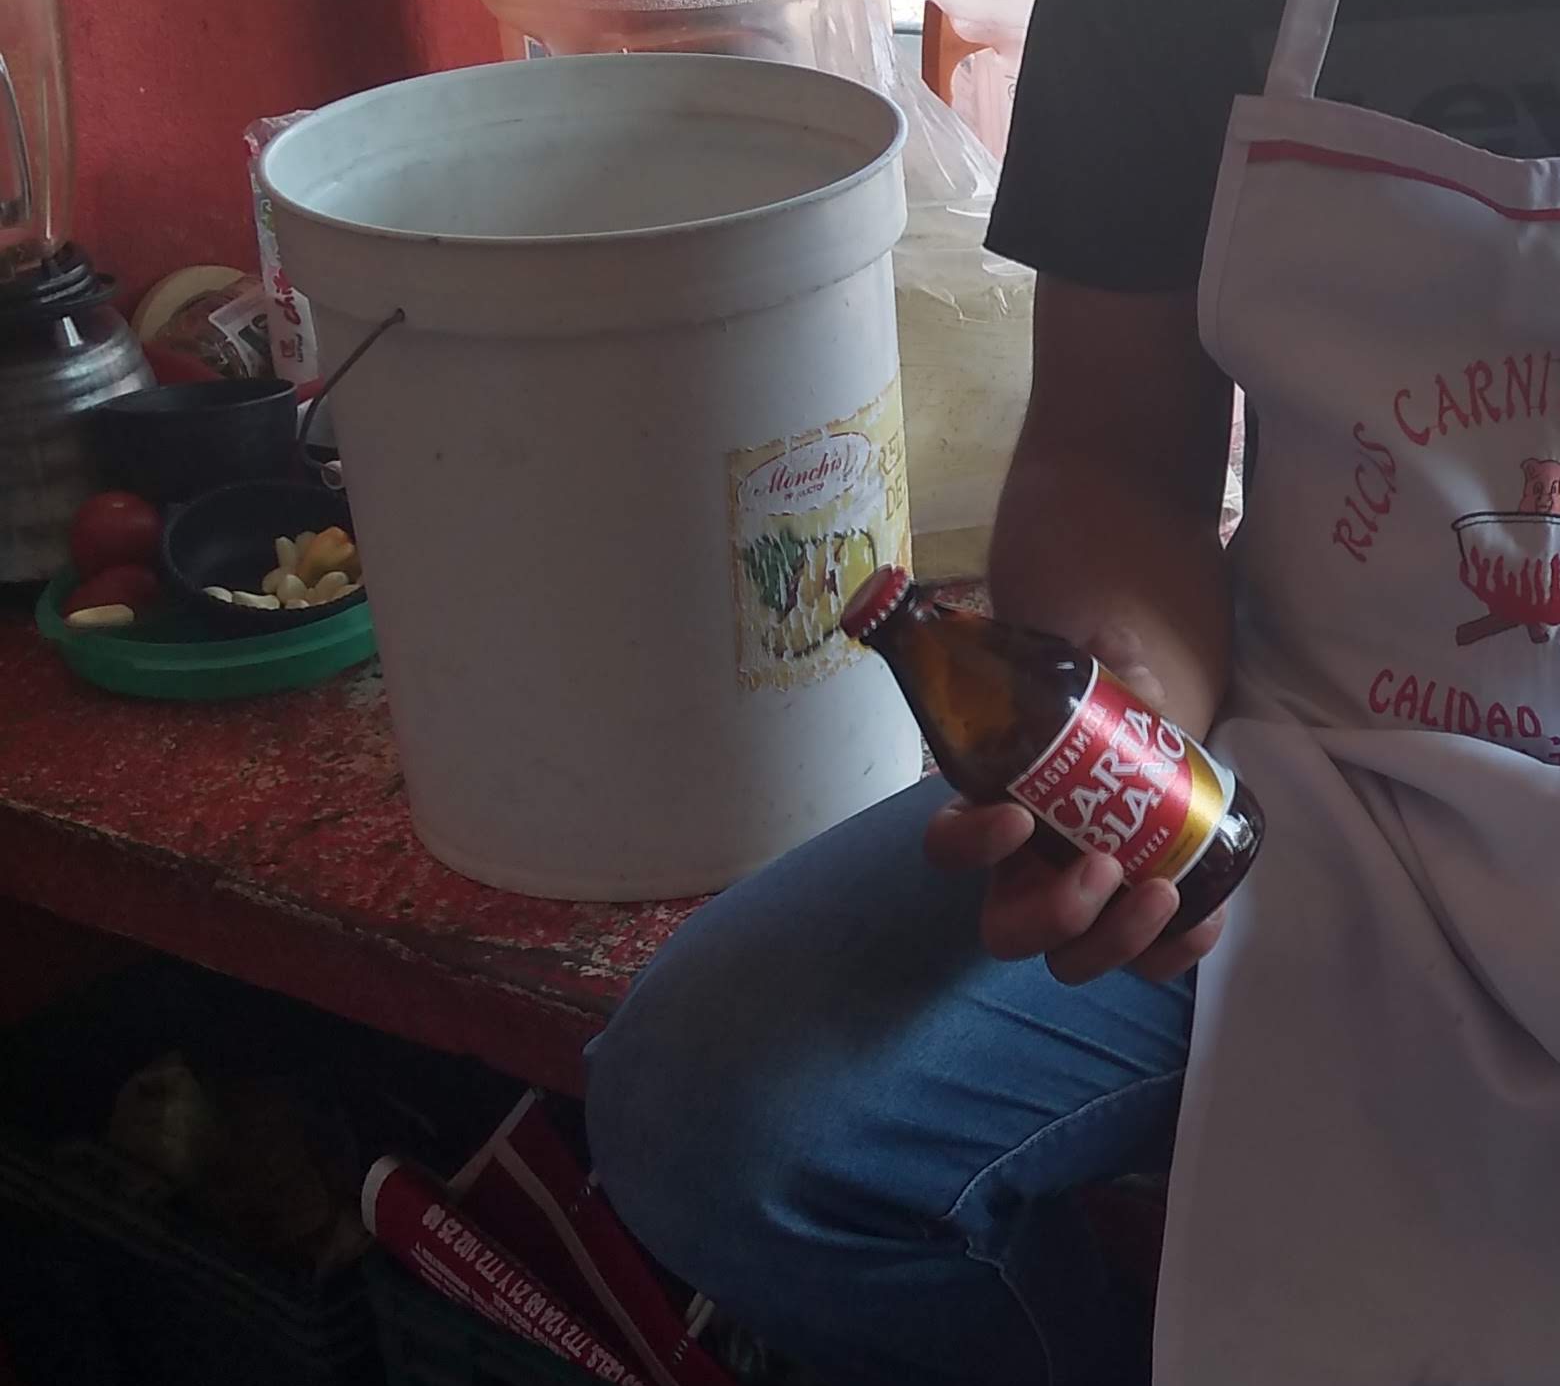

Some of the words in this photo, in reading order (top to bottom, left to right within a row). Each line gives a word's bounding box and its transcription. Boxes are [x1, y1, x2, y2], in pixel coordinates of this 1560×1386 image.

[1046, 706, 1153, 833] CARTA
[1075, 716, 1186, 856] BLANCA
[474, 1249, 506, 1283] 772
[495, 1269, 515, 1294] Y
[561, 1323, 592, 1358] 772
